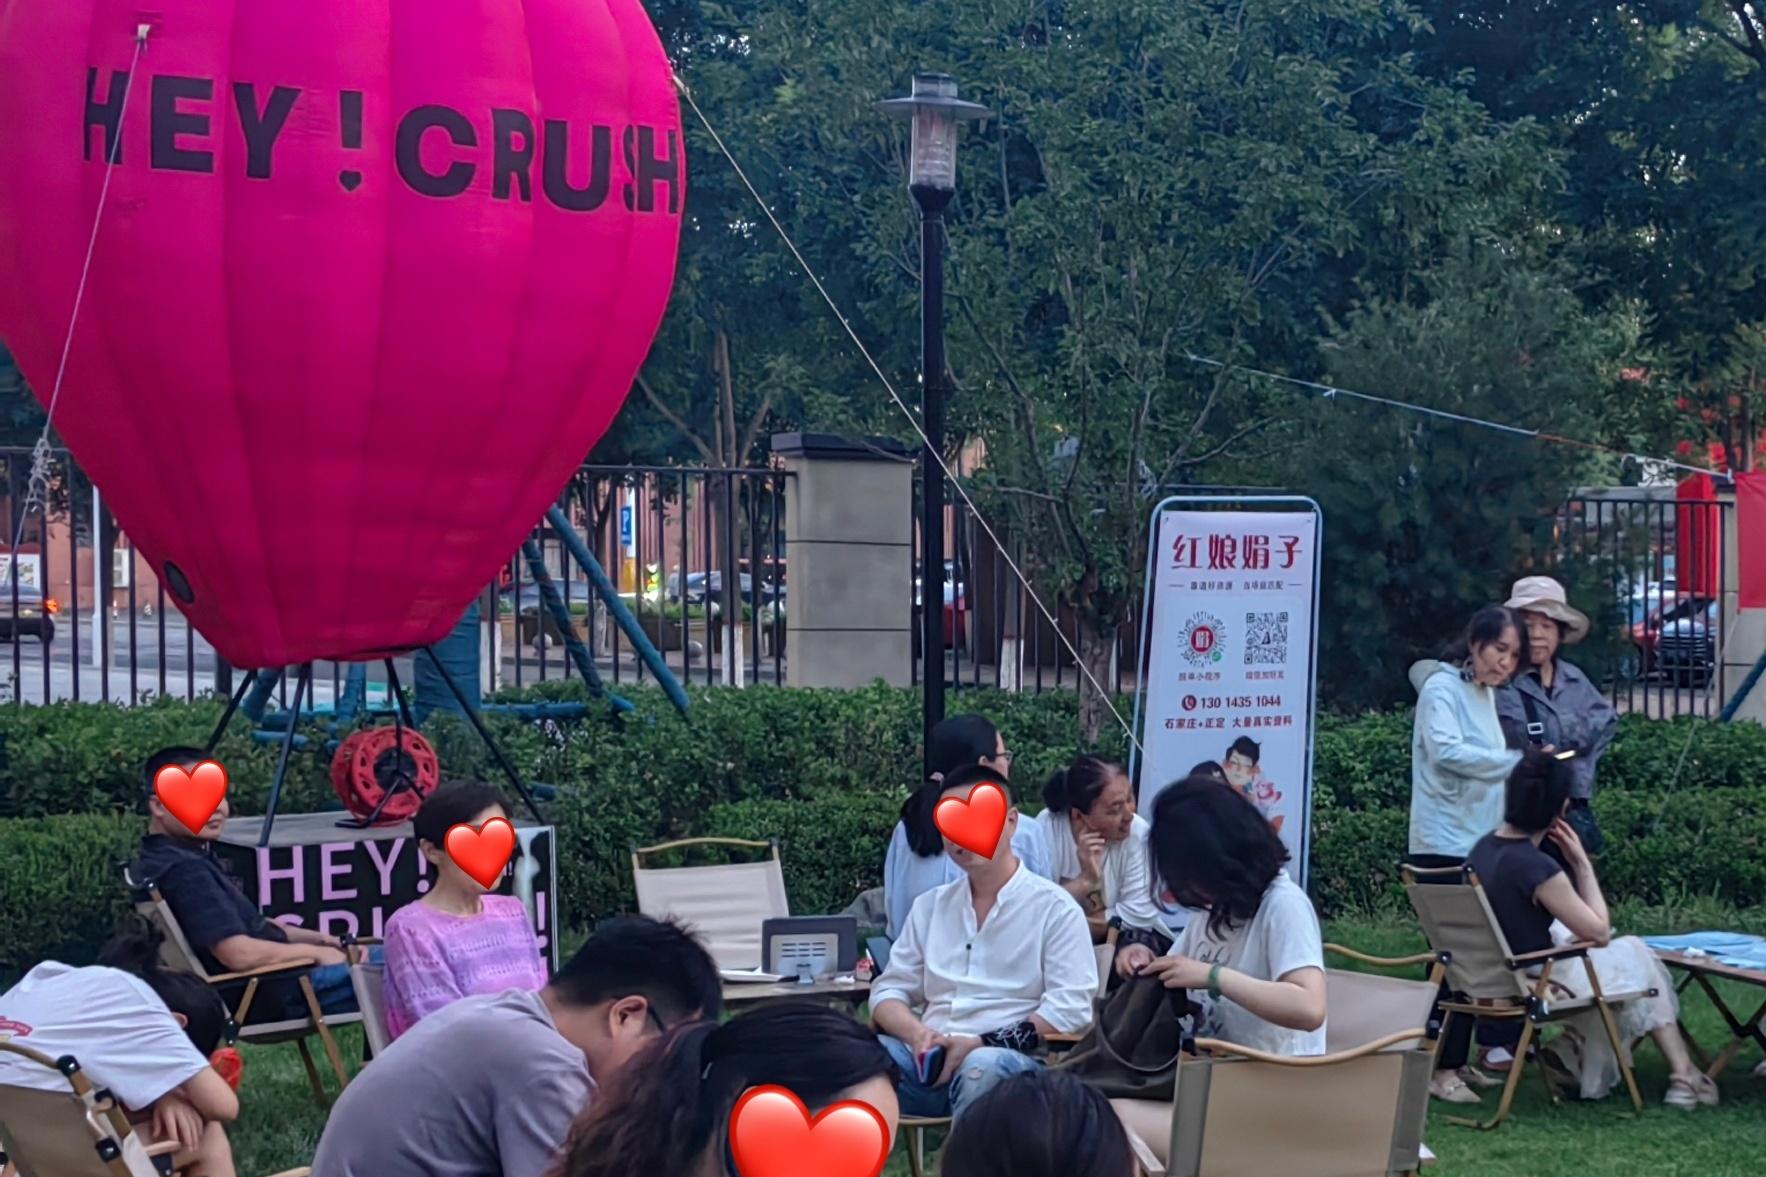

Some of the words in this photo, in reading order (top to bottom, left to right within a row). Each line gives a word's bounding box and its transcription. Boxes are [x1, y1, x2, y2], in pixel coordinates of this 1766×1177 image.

[1170, 533, 1303, 570] 红娘娟子
[1201, 696, 1221, 709] 130
[1225, 696, 1252, 708] 1435
[1256, 695, 1281, 707] 1044
[257, 838, 430, 906] HEY!
